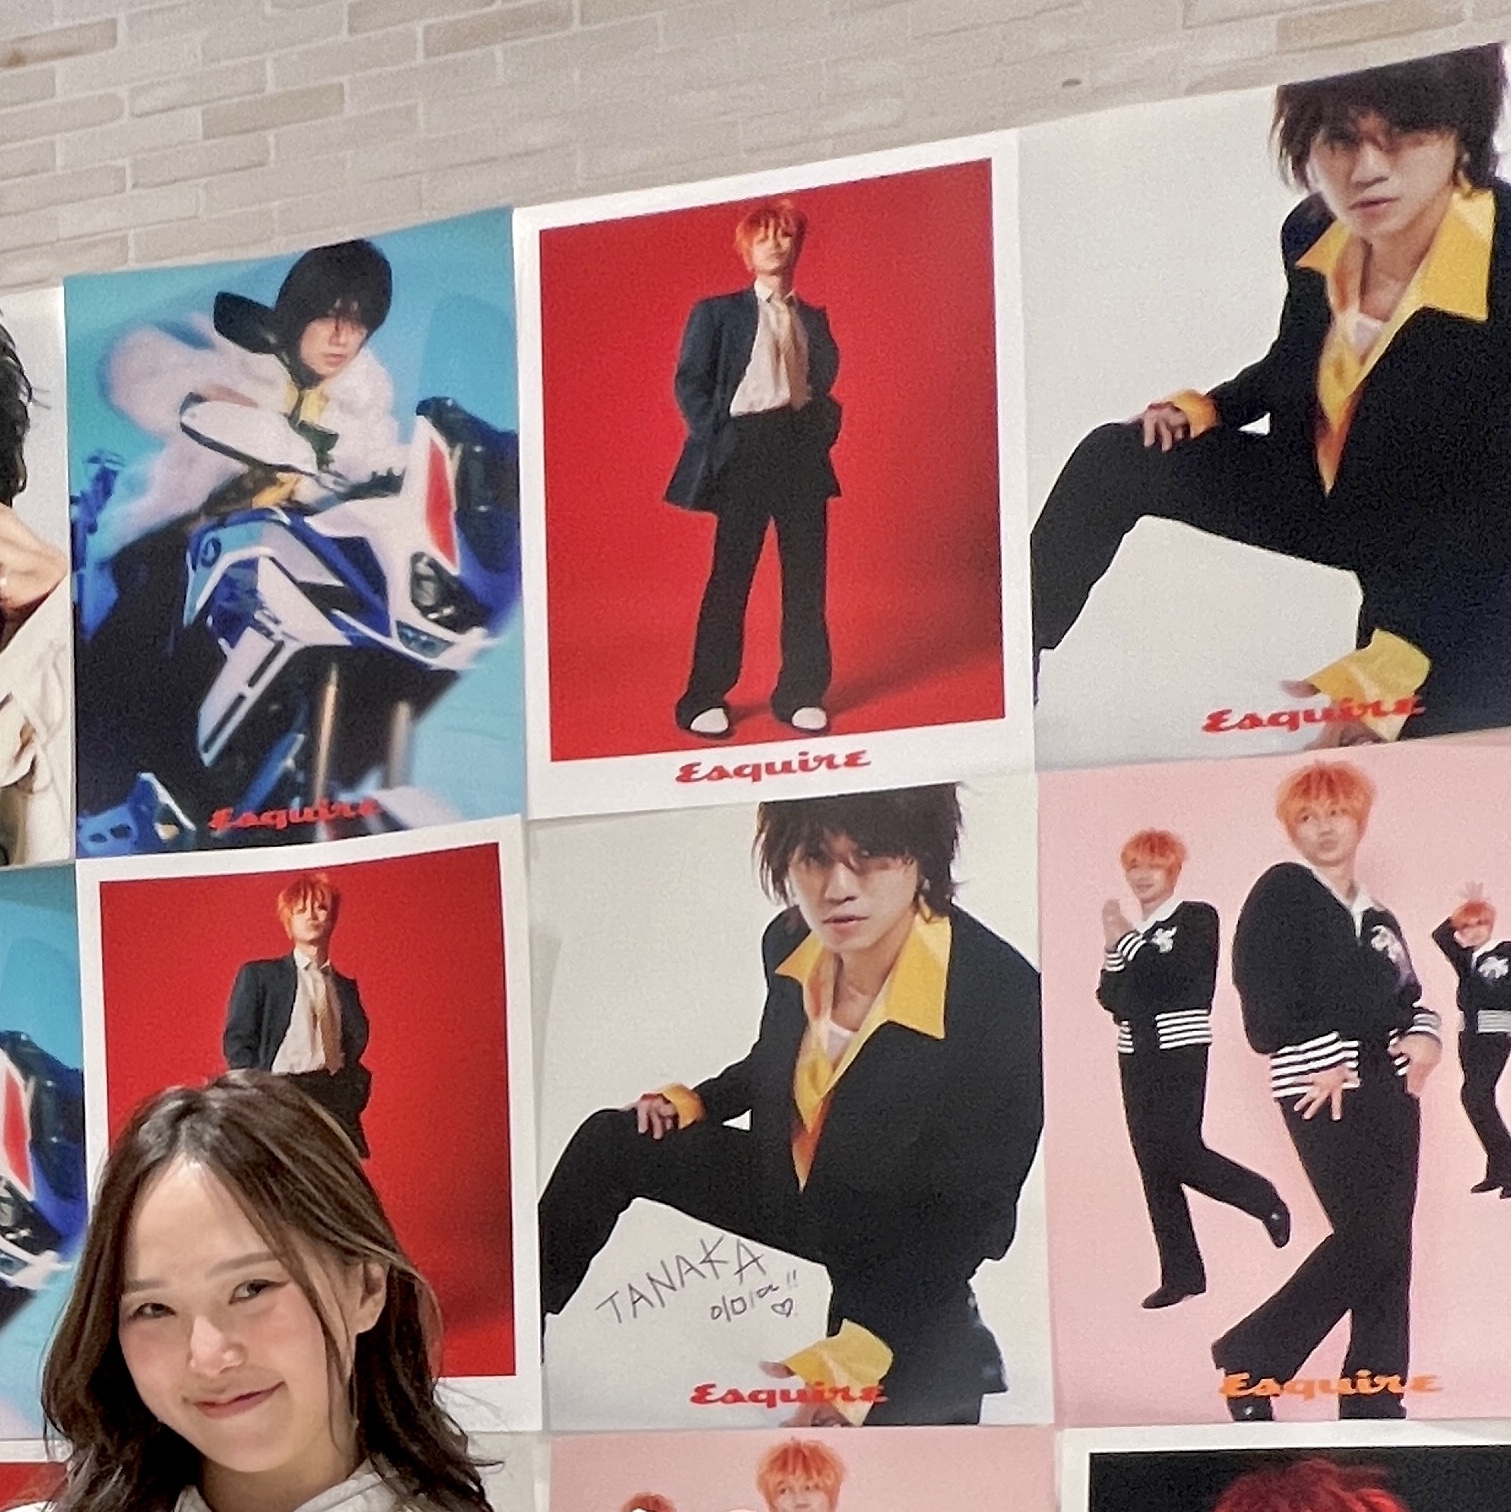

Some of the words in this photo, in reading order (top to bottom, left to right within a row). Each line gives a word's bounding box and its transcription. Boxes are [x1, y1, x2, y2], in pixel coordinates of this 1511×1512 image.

[1202, 695, 1426, 734] Esquire
[676, 748, 871, 784] Esquire
[208, 795, 383, 831] Esquire
[595, 1235, 767, 1324] TANAKA
[689, 1382, 889, 1409] Esquire
[1218, 1370, 1444, 1401] Esquire
